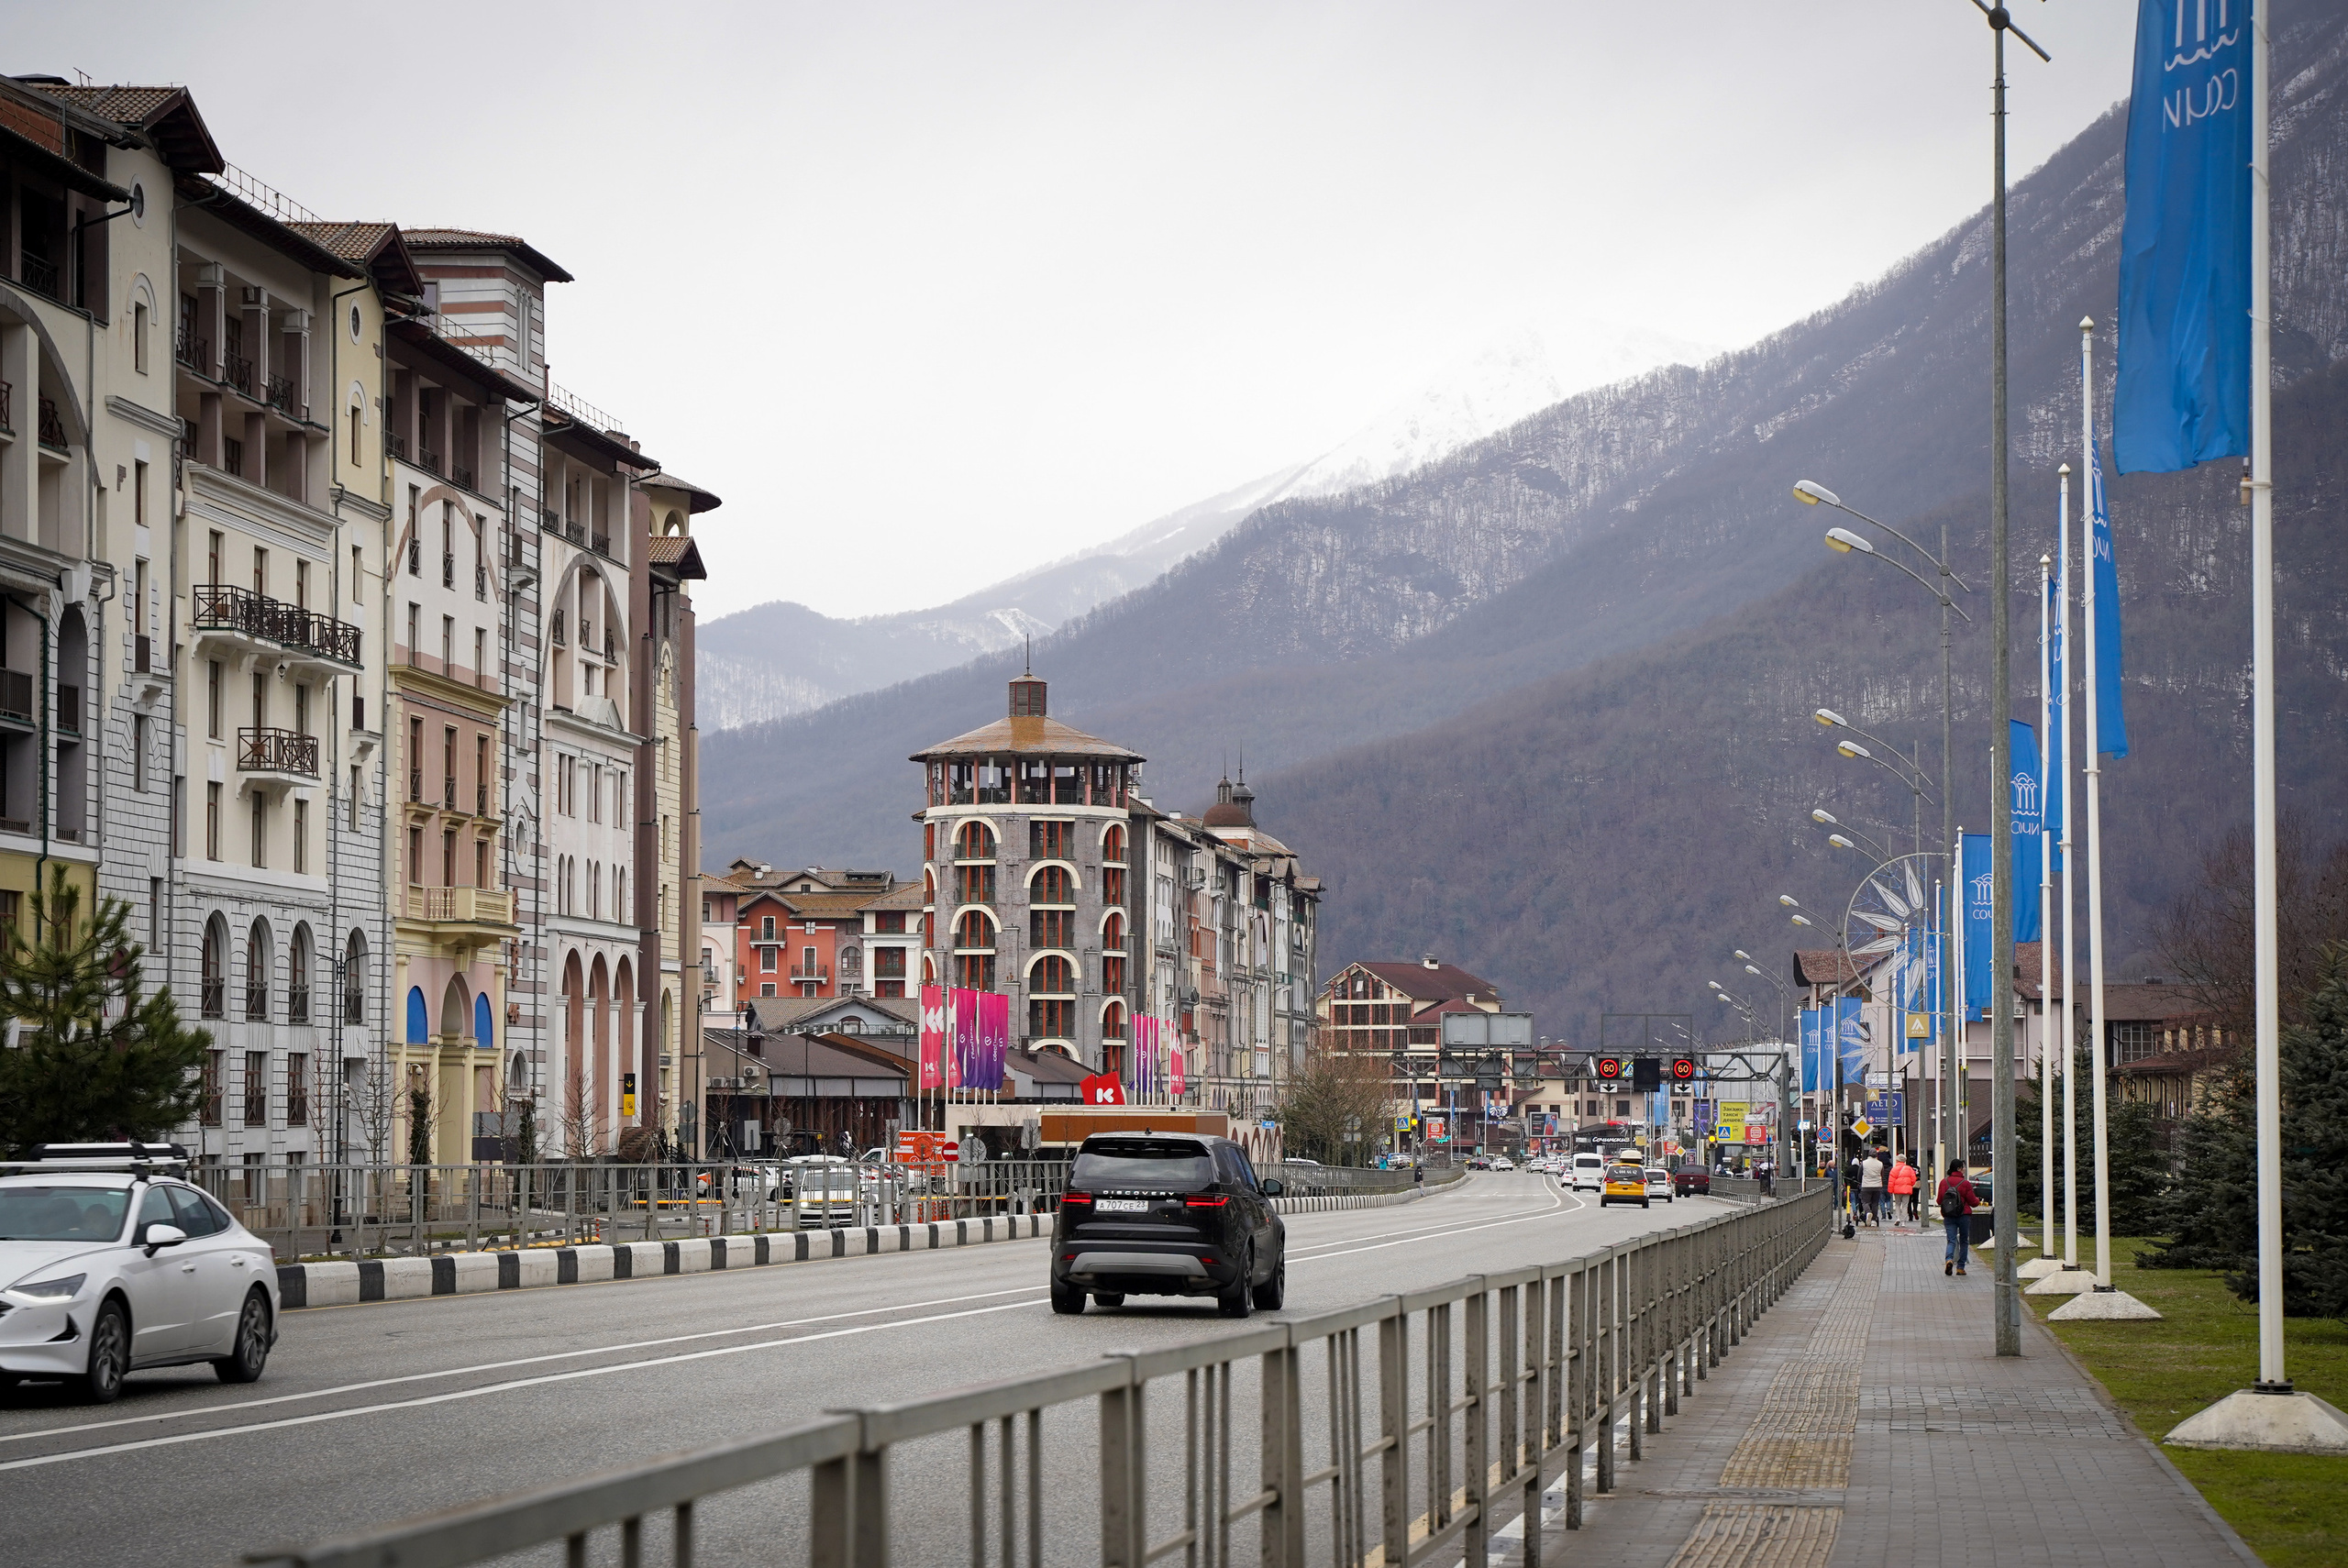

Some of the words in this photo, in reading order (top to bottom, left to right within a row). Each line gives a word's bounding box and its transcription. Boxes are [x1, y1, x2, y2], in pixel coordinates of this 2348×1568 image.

[2010, 821, 2040, 835] СОЧИ
[1972, 909, 1992, 920] СОЧ
[507, 1002, 520, 1024] 46
[1603, 1065, 1614, 1073] 60
[1678, 1065, 1689, 1073] 60
